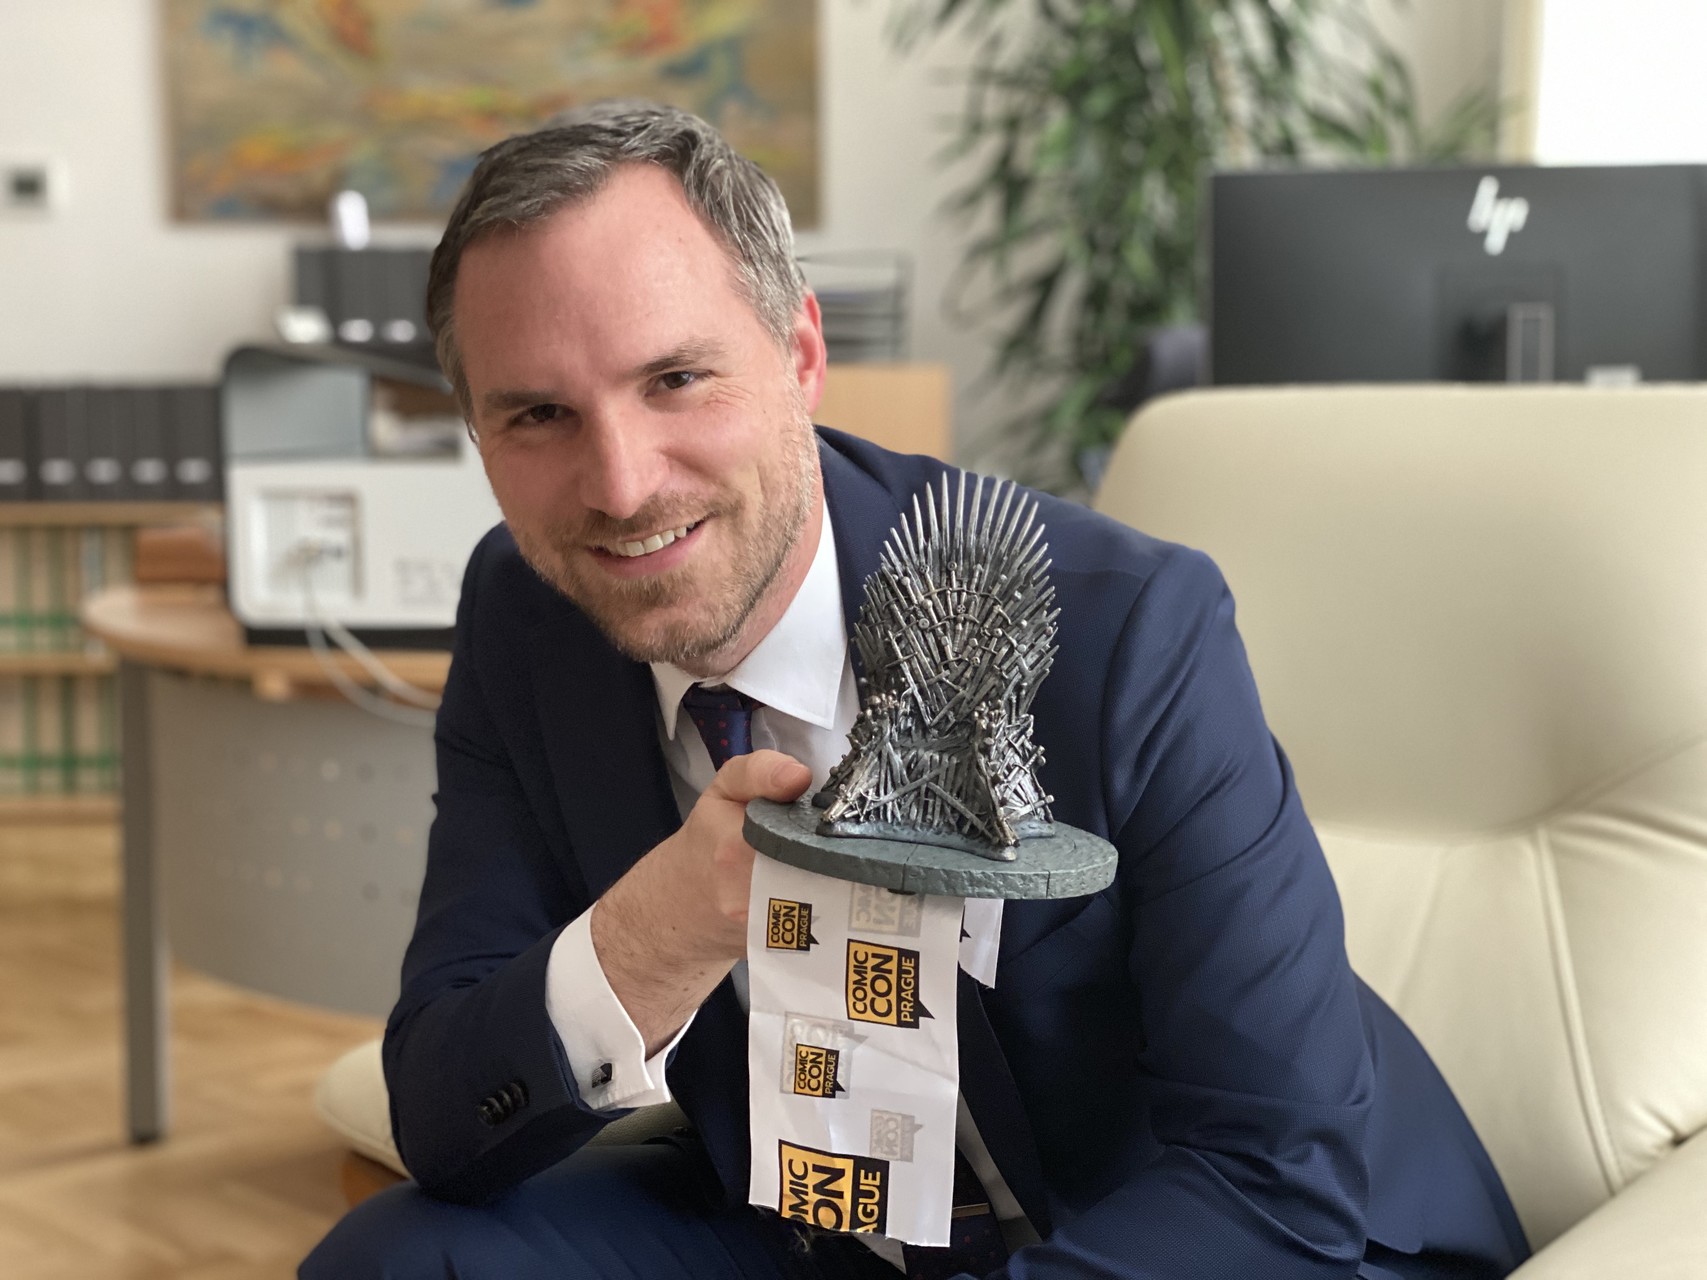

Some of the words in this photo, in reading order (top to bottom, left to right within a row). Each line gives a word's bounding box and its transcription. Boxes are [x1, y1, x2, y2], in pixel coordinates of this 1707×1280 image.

[771, 904, 782, 943] COMIC
[781, 905, 797, 945] CON
[799, 906, 809, 947] PRAGUE
[852, 950, 869, 1015] COMIC
[869, 953, 893, 1018] CON
[901, 956, 915, 1022] PRAGUE
[798, 1050, 809, 1090] COMIC
[807, 1051, 824, 1092] CON
[824, 1054, 836, 1094] PRAGUE
[788, 1159, 809, 1223] MIC
[812, 1164, 846, 1229] ON
[857, 1169, 881, 1233] AGUE
